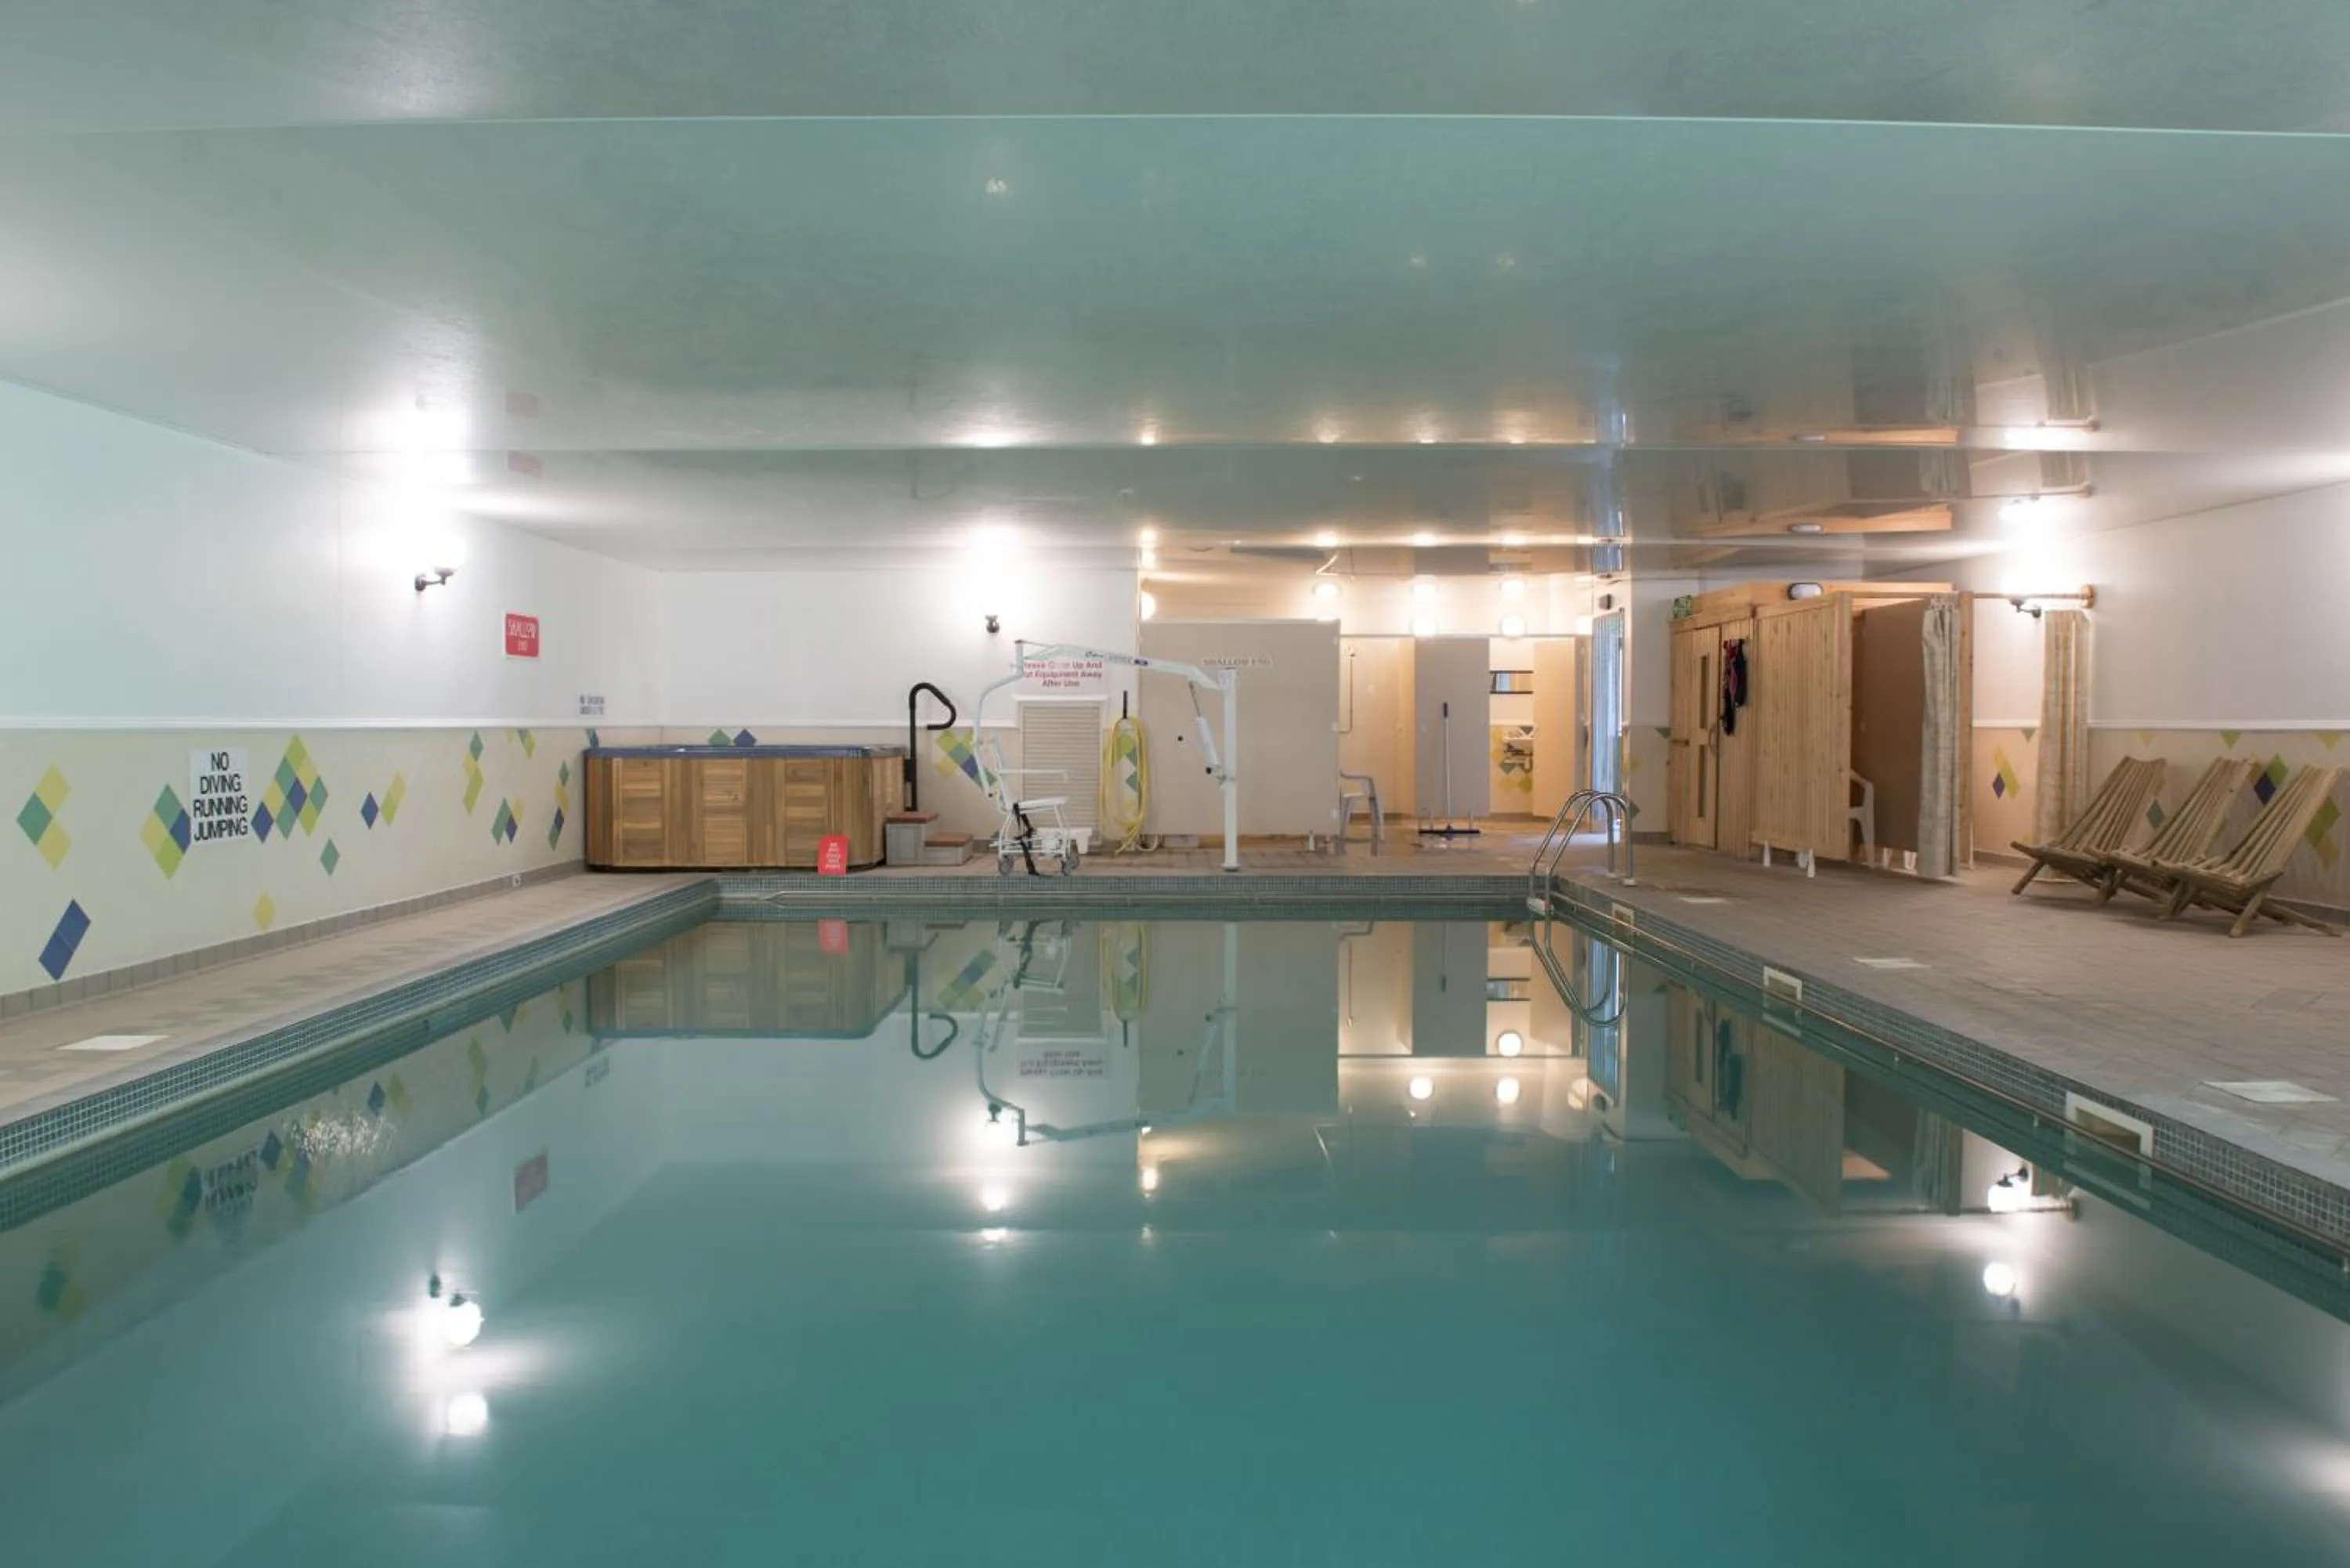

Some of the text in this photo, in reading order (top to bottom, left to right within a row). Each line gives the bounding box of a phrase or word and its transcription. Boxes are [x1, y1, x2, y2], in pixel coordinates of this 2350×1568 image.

[1072, 661, 1084, 670] Up
[1080, 671, 1102, 681] Away
[211, 751, 230, 771] NO
[200, 773, 241, 795] DIVING
[193, 795, 248, 818] RUNNING
[193, 816, 248, 841] JUMPING
